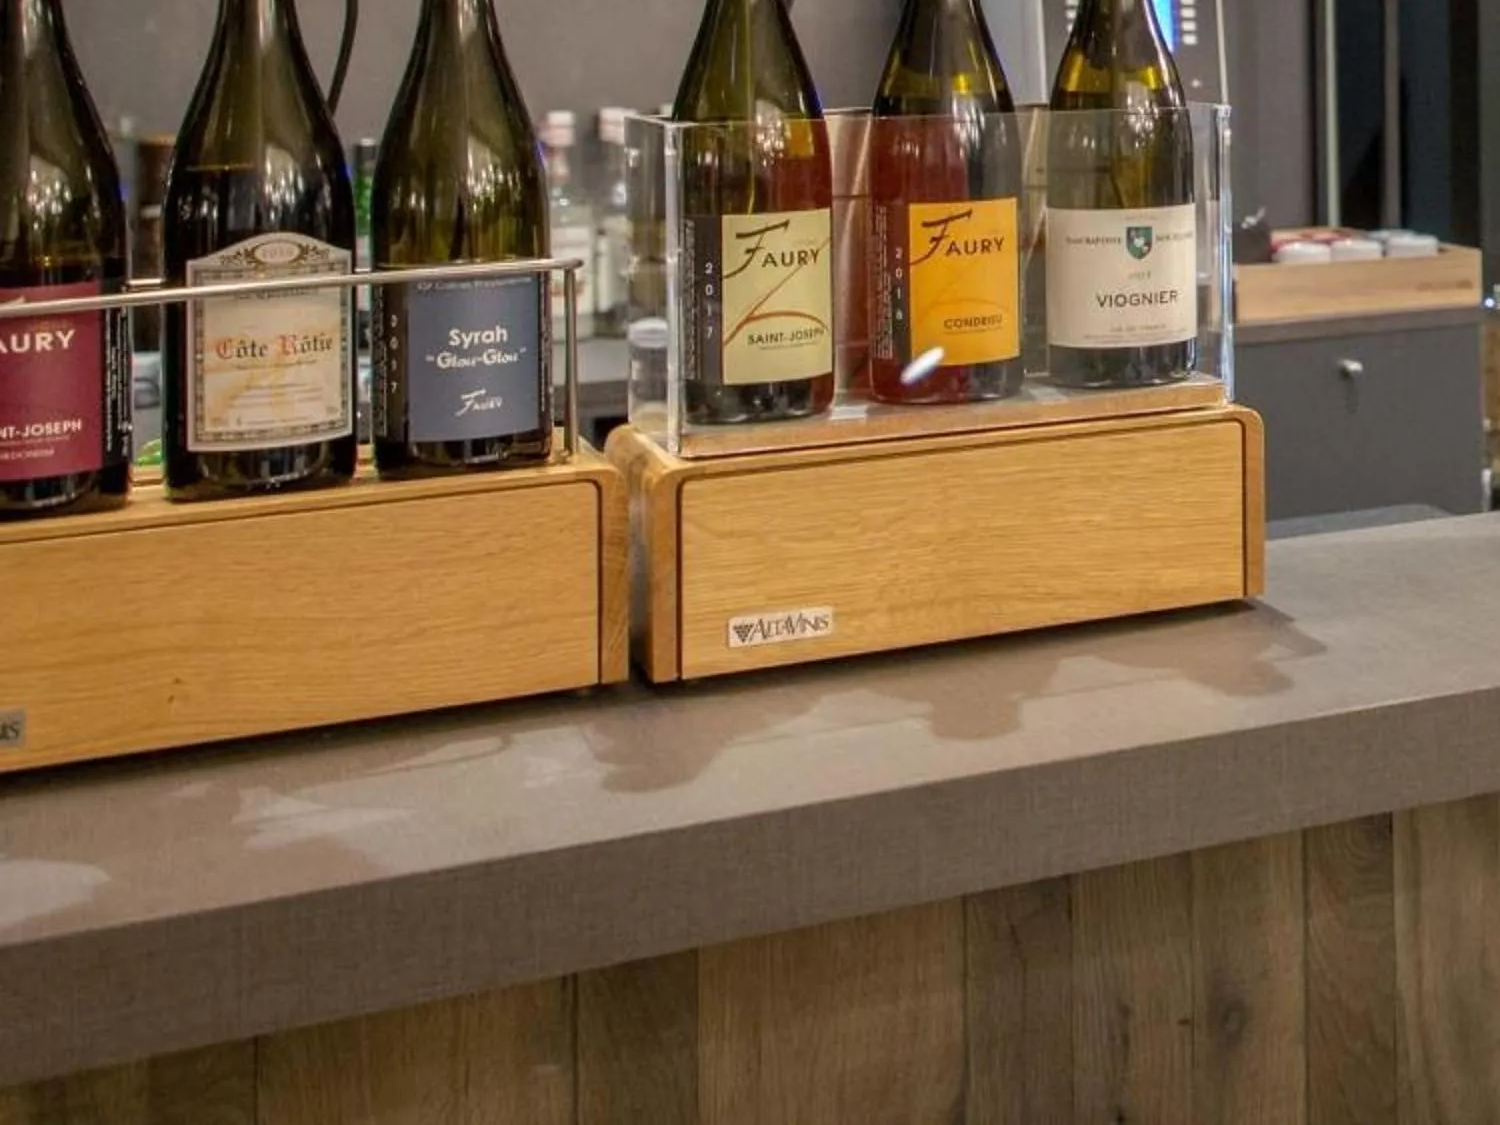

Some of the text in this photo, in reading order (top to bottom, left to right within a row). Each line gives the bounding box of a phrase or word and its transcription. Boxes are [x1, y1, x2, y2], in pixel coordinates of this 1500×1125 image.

[722, 219, 820, 279] FAURY
[910, 209, 1004, 266] FAURY
[1096, 290, 1178, 308] VIOGNIER
[449, 325, 508, 349] Syrah
